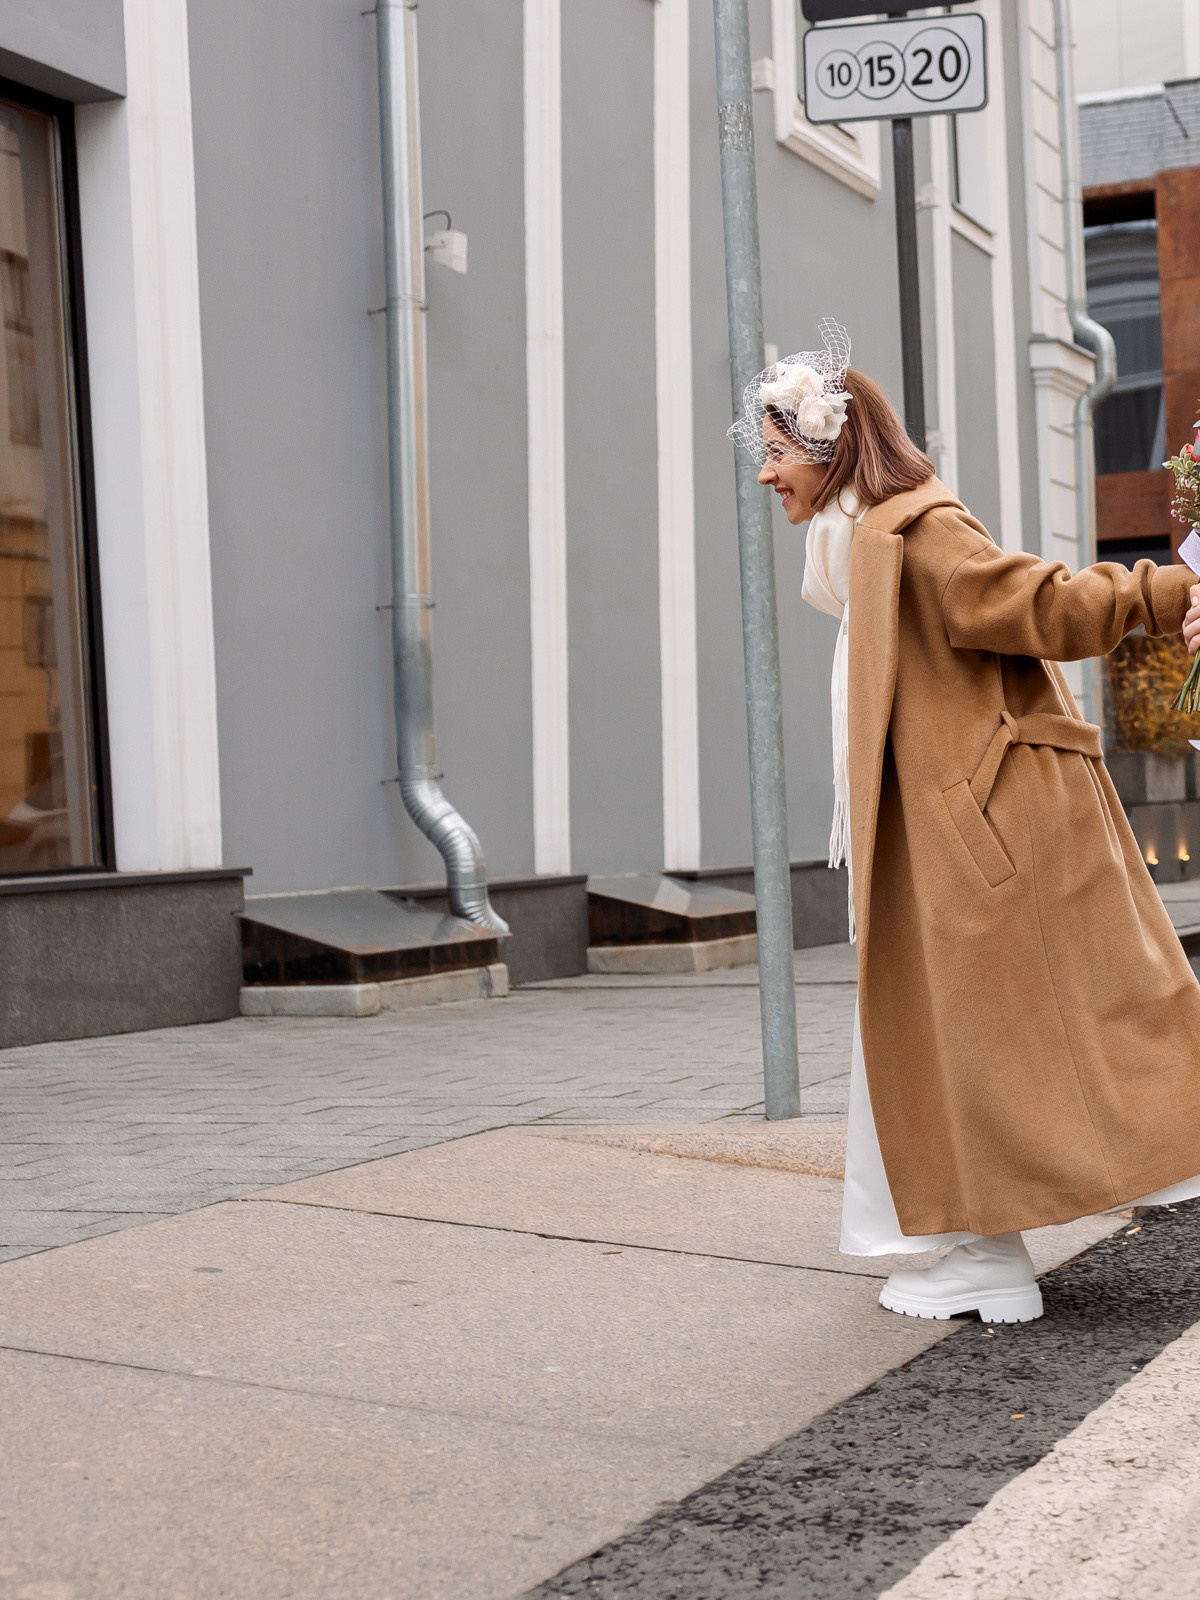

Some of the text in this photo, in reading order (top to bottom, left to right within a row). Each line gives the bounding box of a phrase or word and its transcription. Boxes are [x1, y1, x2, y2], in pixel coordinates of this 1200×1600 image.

[826, 45, 962, 87] 10 15 20
